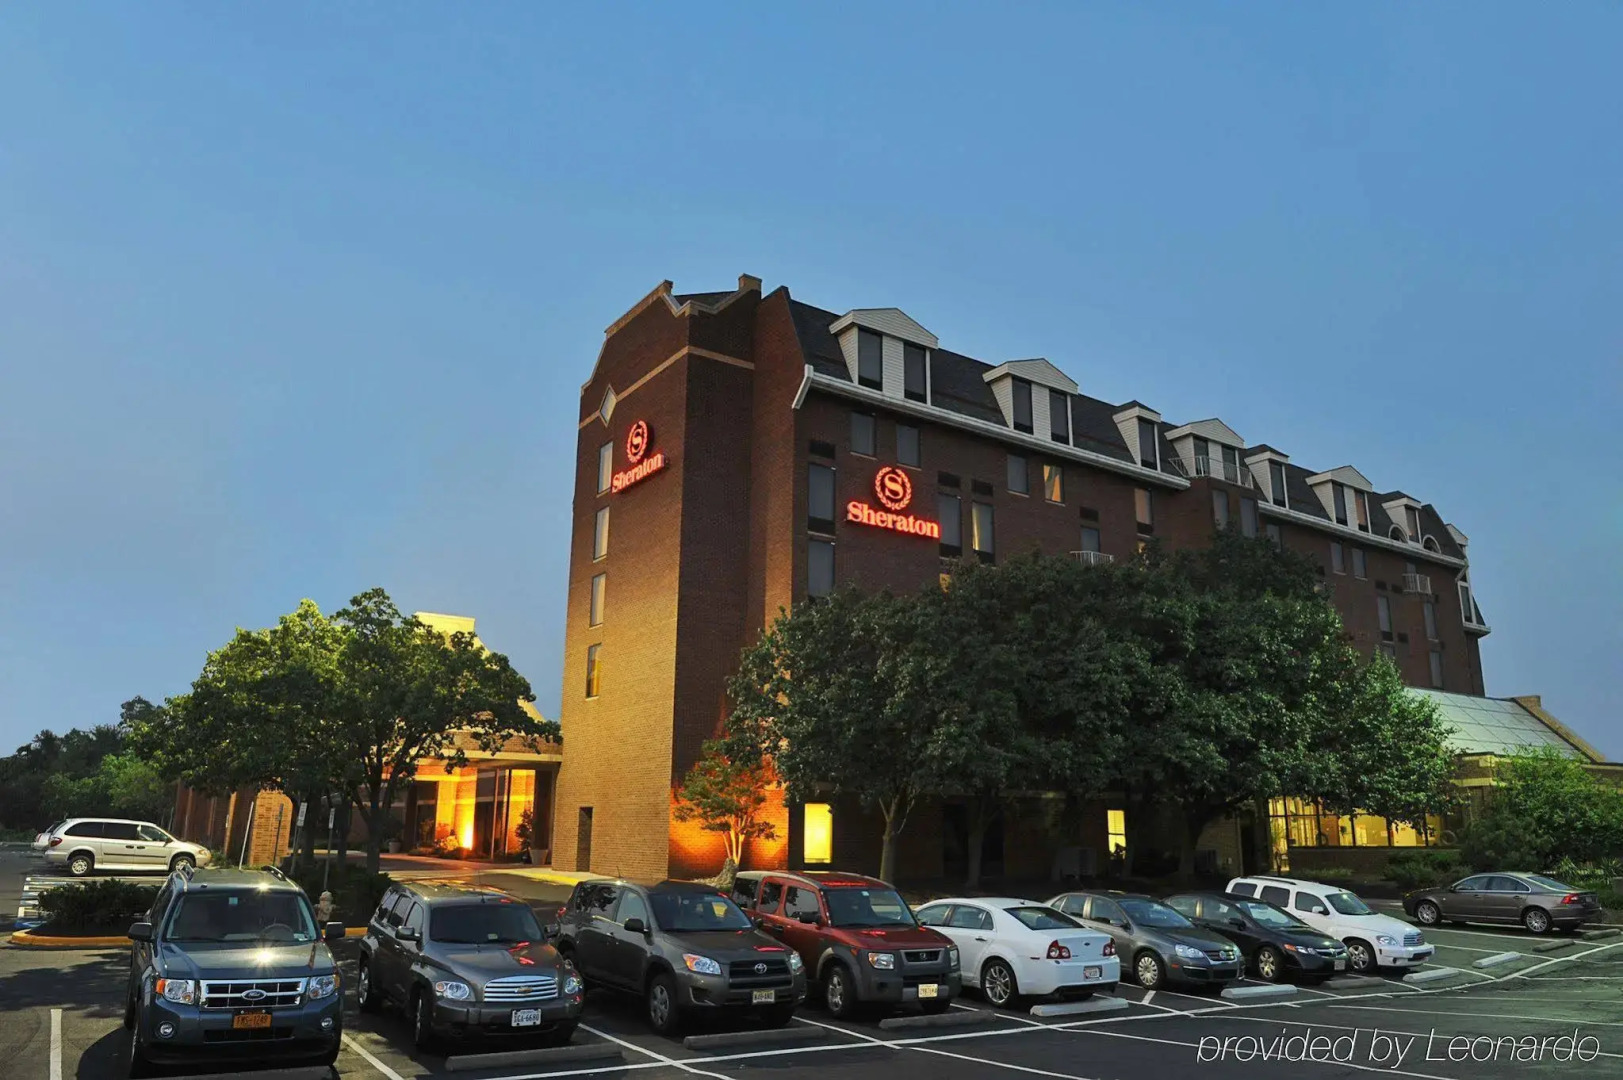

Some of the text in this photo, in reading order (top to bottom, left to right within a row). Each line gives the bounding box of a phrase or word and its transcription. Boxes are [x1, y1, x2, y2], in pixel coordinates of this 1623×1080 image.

[630, 428, 643, 454] S
[612, 453, 663, 493] Sheraton
[884, 473, 904, 499] S
[846, 501, 939, 538] Sheraton
